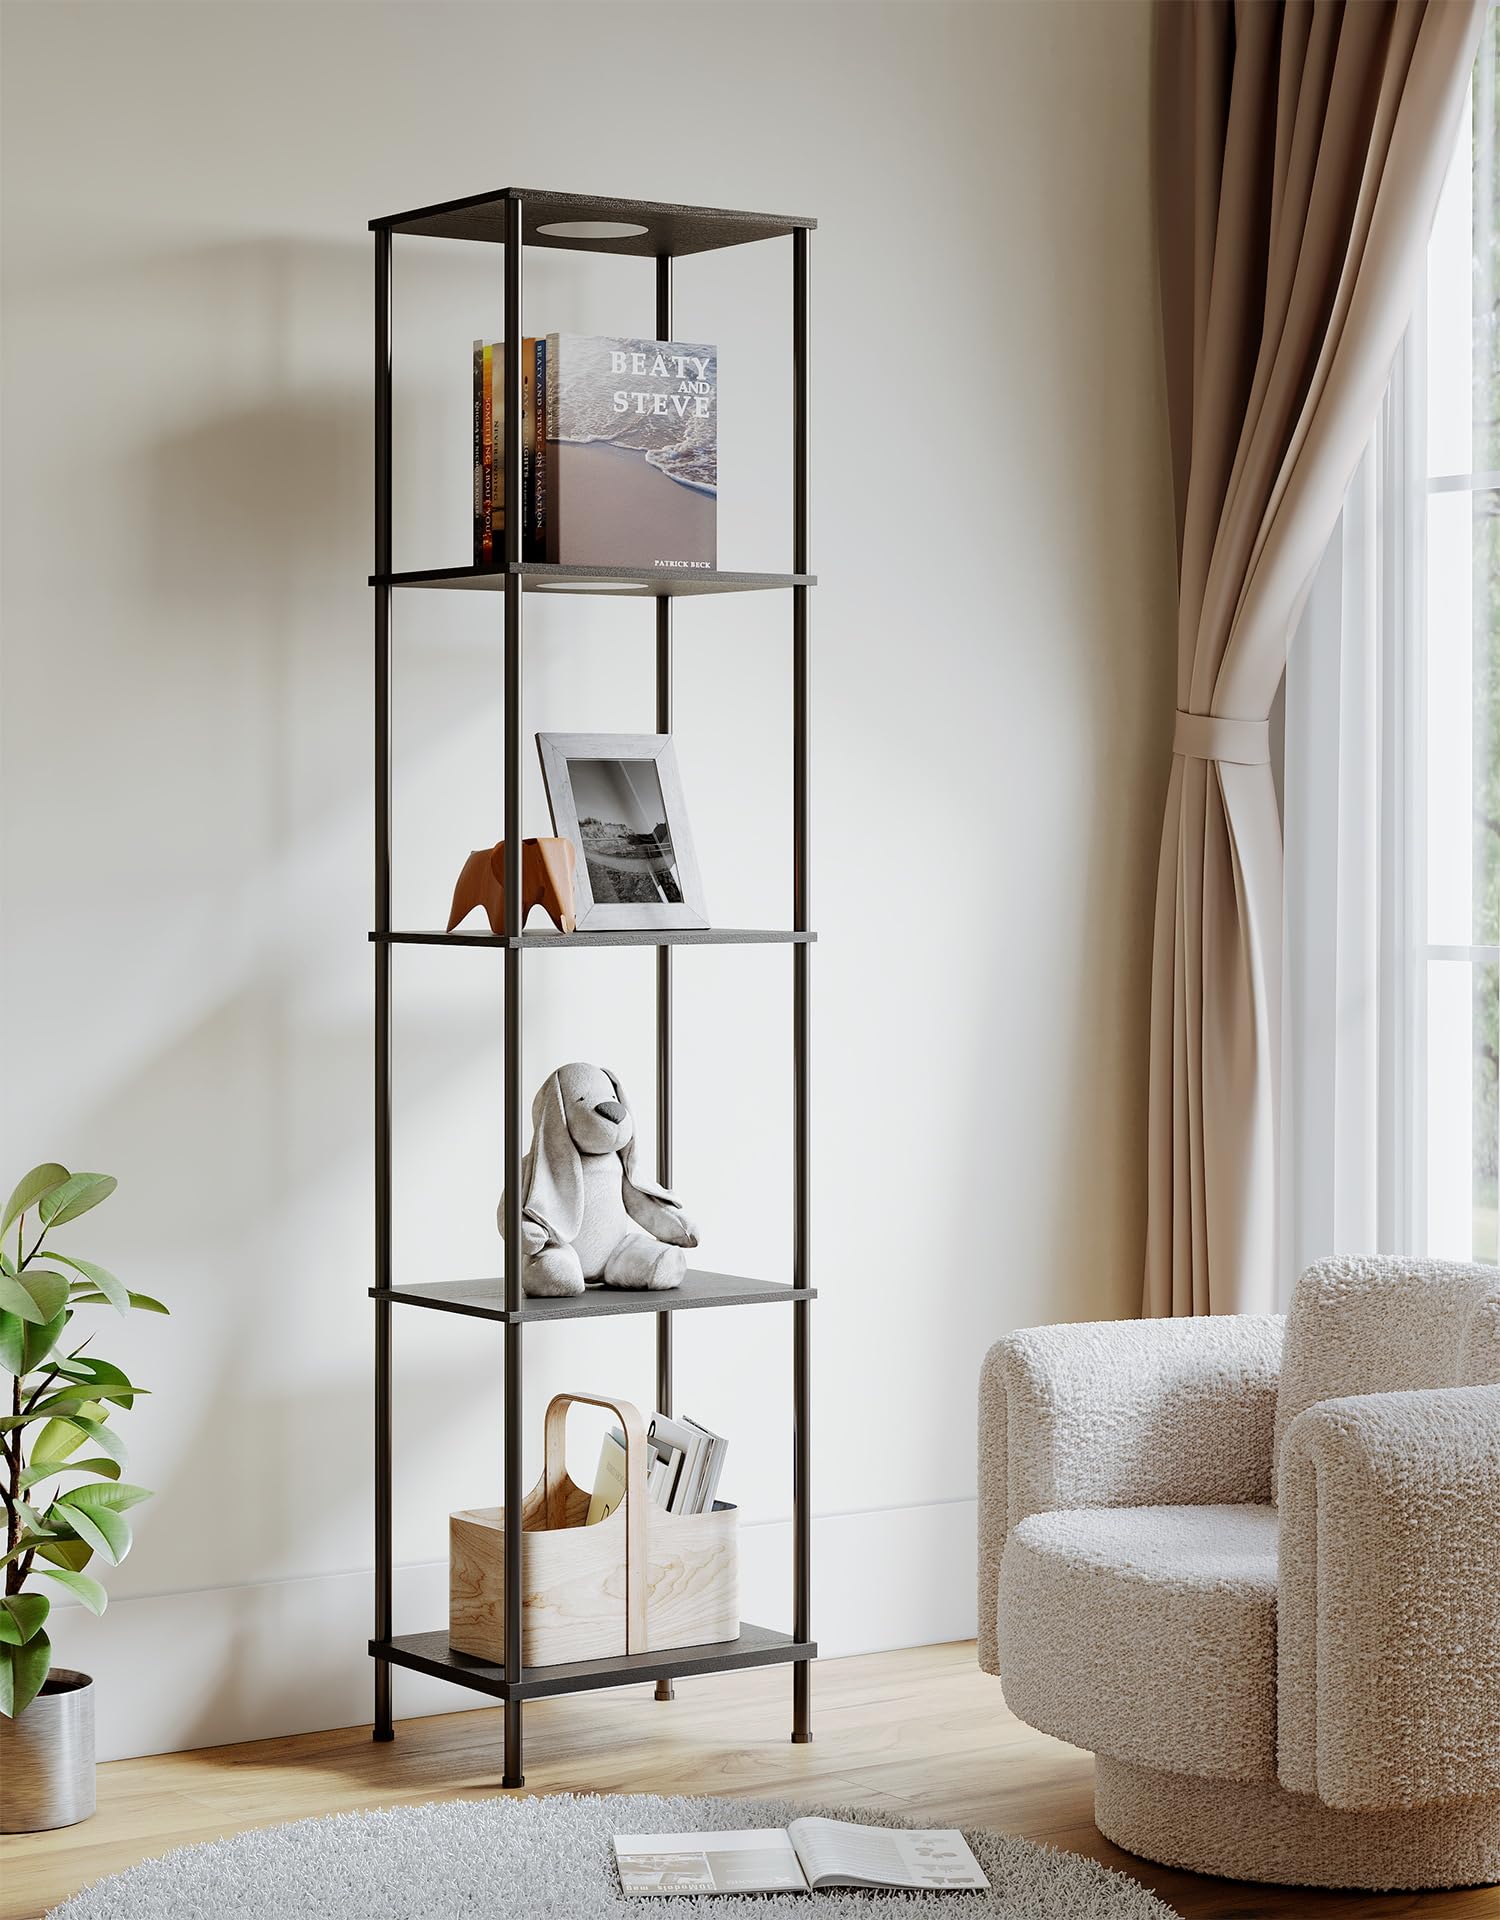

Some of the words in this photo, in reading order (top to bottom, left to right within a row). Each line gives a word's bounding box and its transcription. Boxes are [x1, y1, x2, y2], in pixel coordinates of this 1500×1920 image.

[609, 350, 711, 380] BEATY
[678, 380, 710, 394] AND
[613, 391, 710, 418] STEVE
[536, 451, 543, 467] ON
[654, 560, 689, 568] PATRICK
[690, 561, 711, 569] BECK
